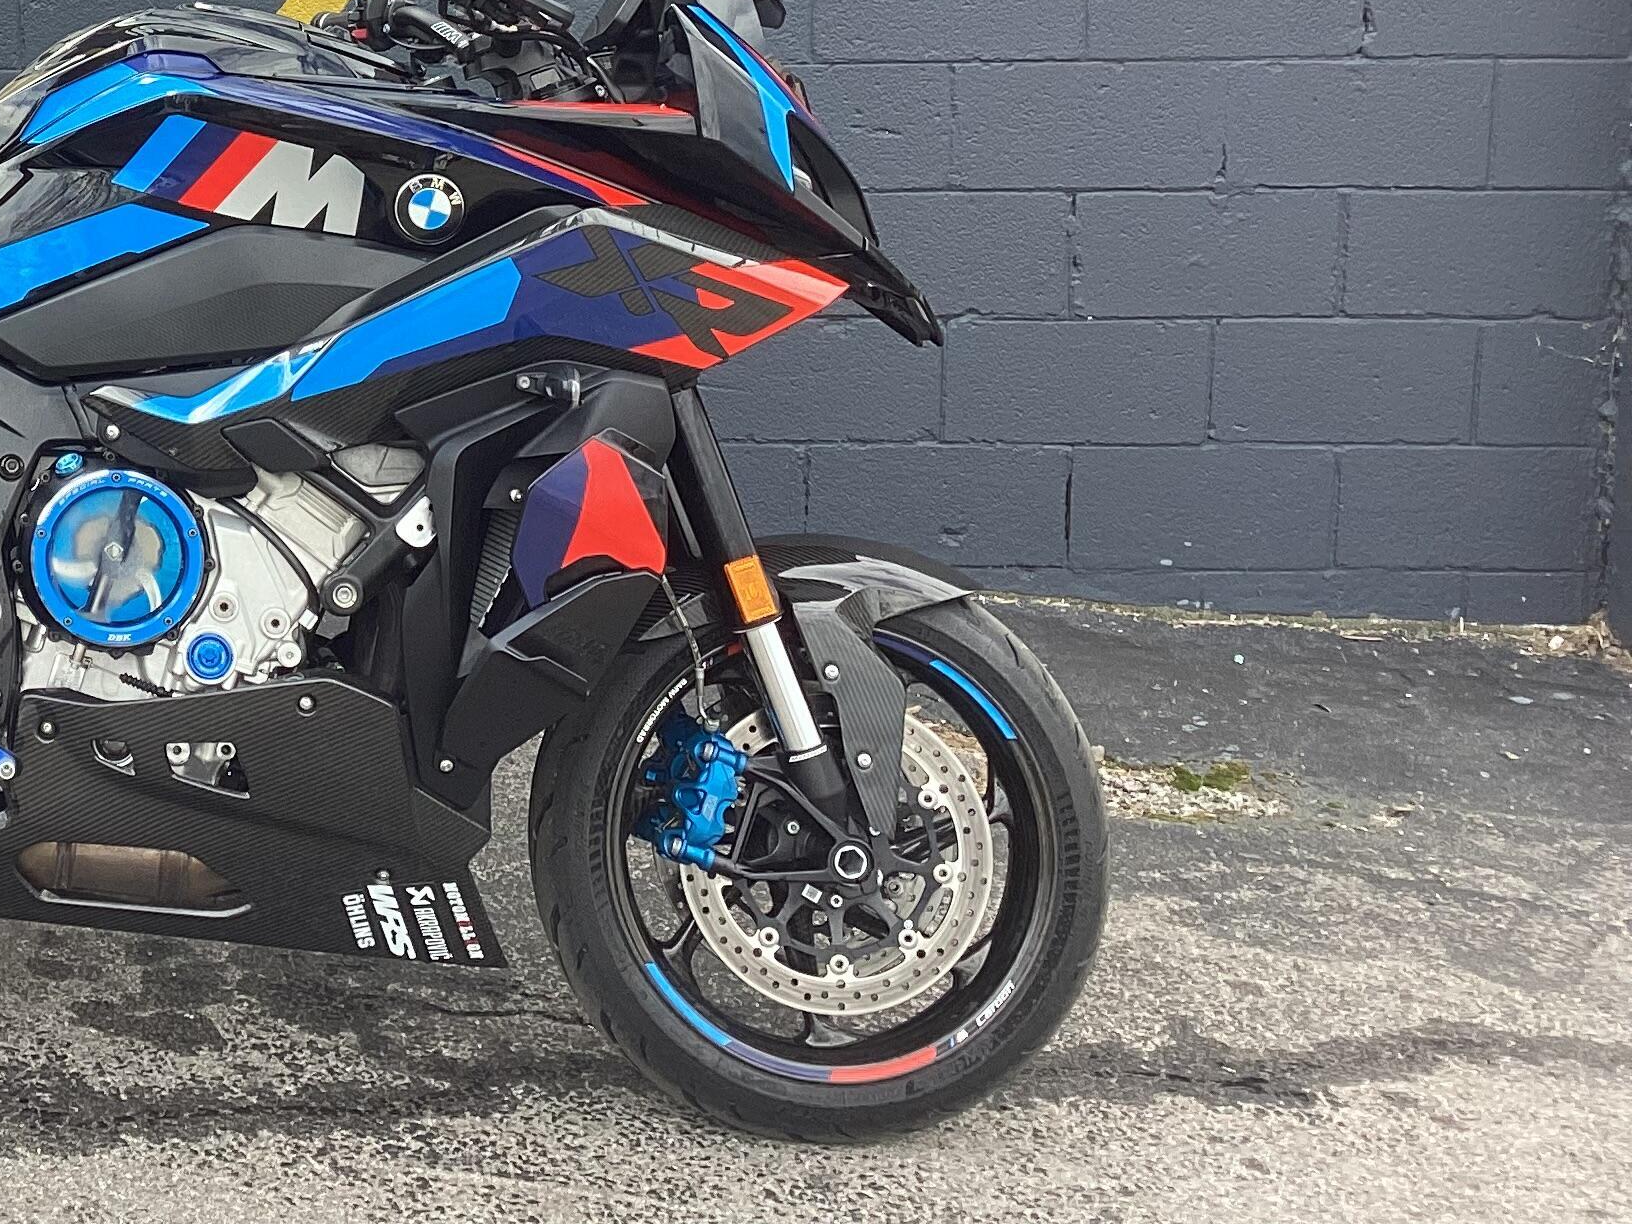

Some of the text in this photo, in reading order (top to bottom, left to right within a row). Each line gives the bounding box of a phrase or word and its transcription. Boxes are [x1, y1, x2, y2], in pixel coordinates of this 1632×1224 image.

[213, 140, 365, 236] M
[409, 177, 462, 206] BMW
[107, 633, 132, 642] DBK
[342, 893, 376, 950] ÖHLINS
